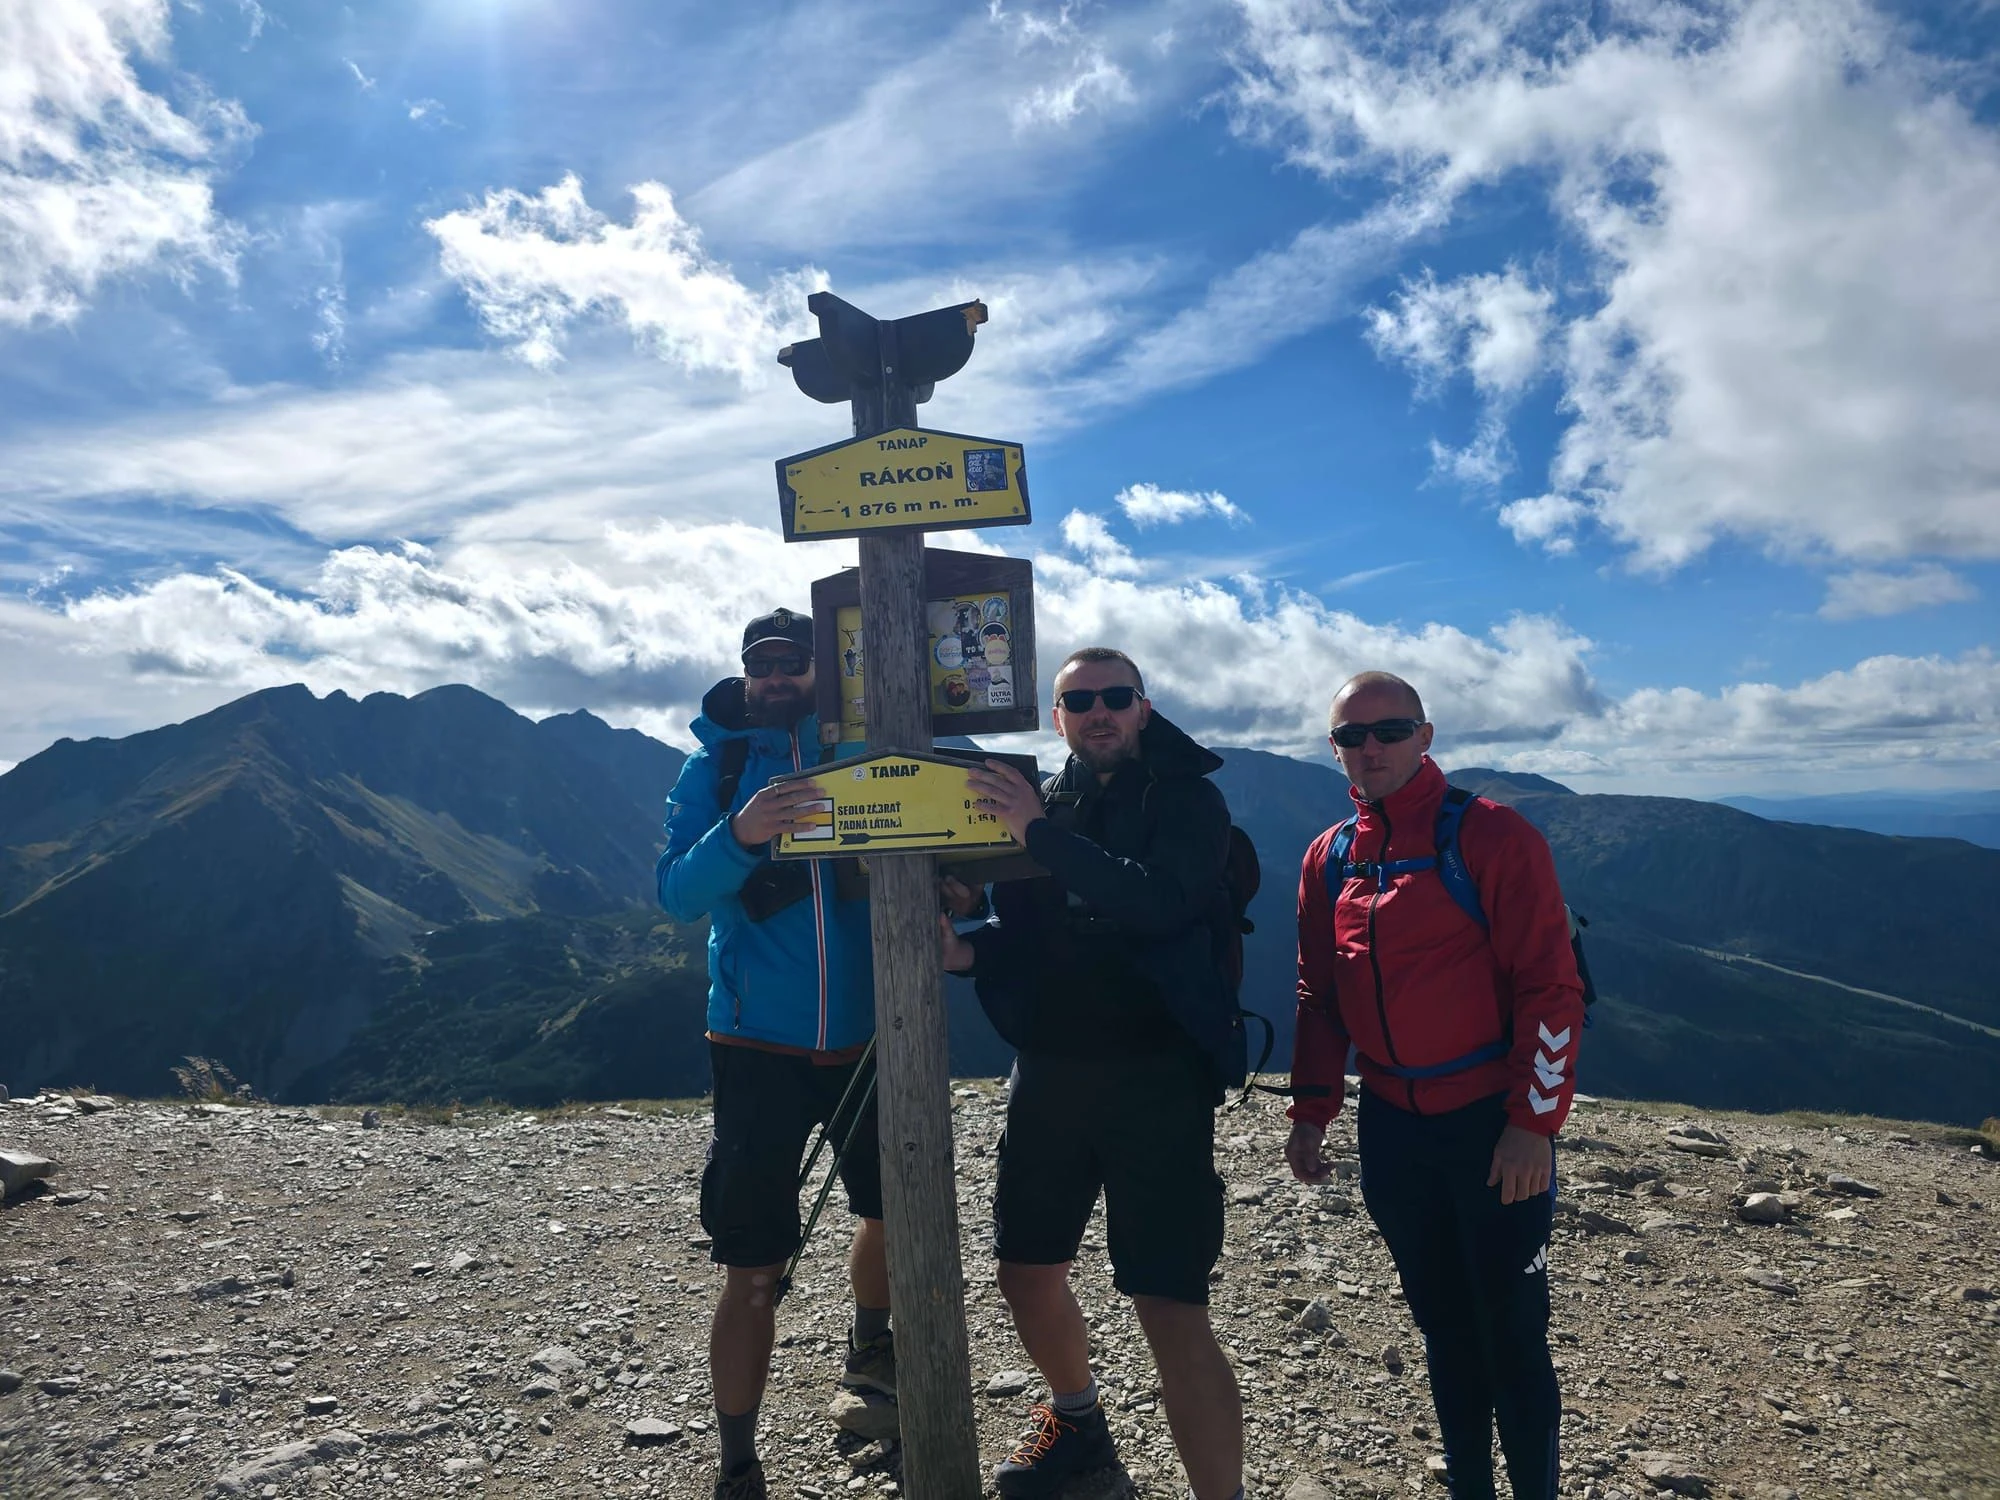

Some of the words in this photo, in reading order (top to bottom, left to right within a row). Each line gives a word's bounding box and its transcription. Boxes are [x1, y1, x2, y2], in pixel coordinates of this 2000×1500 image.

[877, 437, 928, 452] TANAP
[860, 461, 953, 487] RÁKOŇ
[841, 506, 850, 518] 1
[859, 502, 897, 517] 876
[904, 502, 922, 512] m
[929, 500, 947, 510] n.
[954, 497, 979, 508] m.
[869, 764, 920, 779] TANAP
[837, 804, 865, 816] SEDLO
